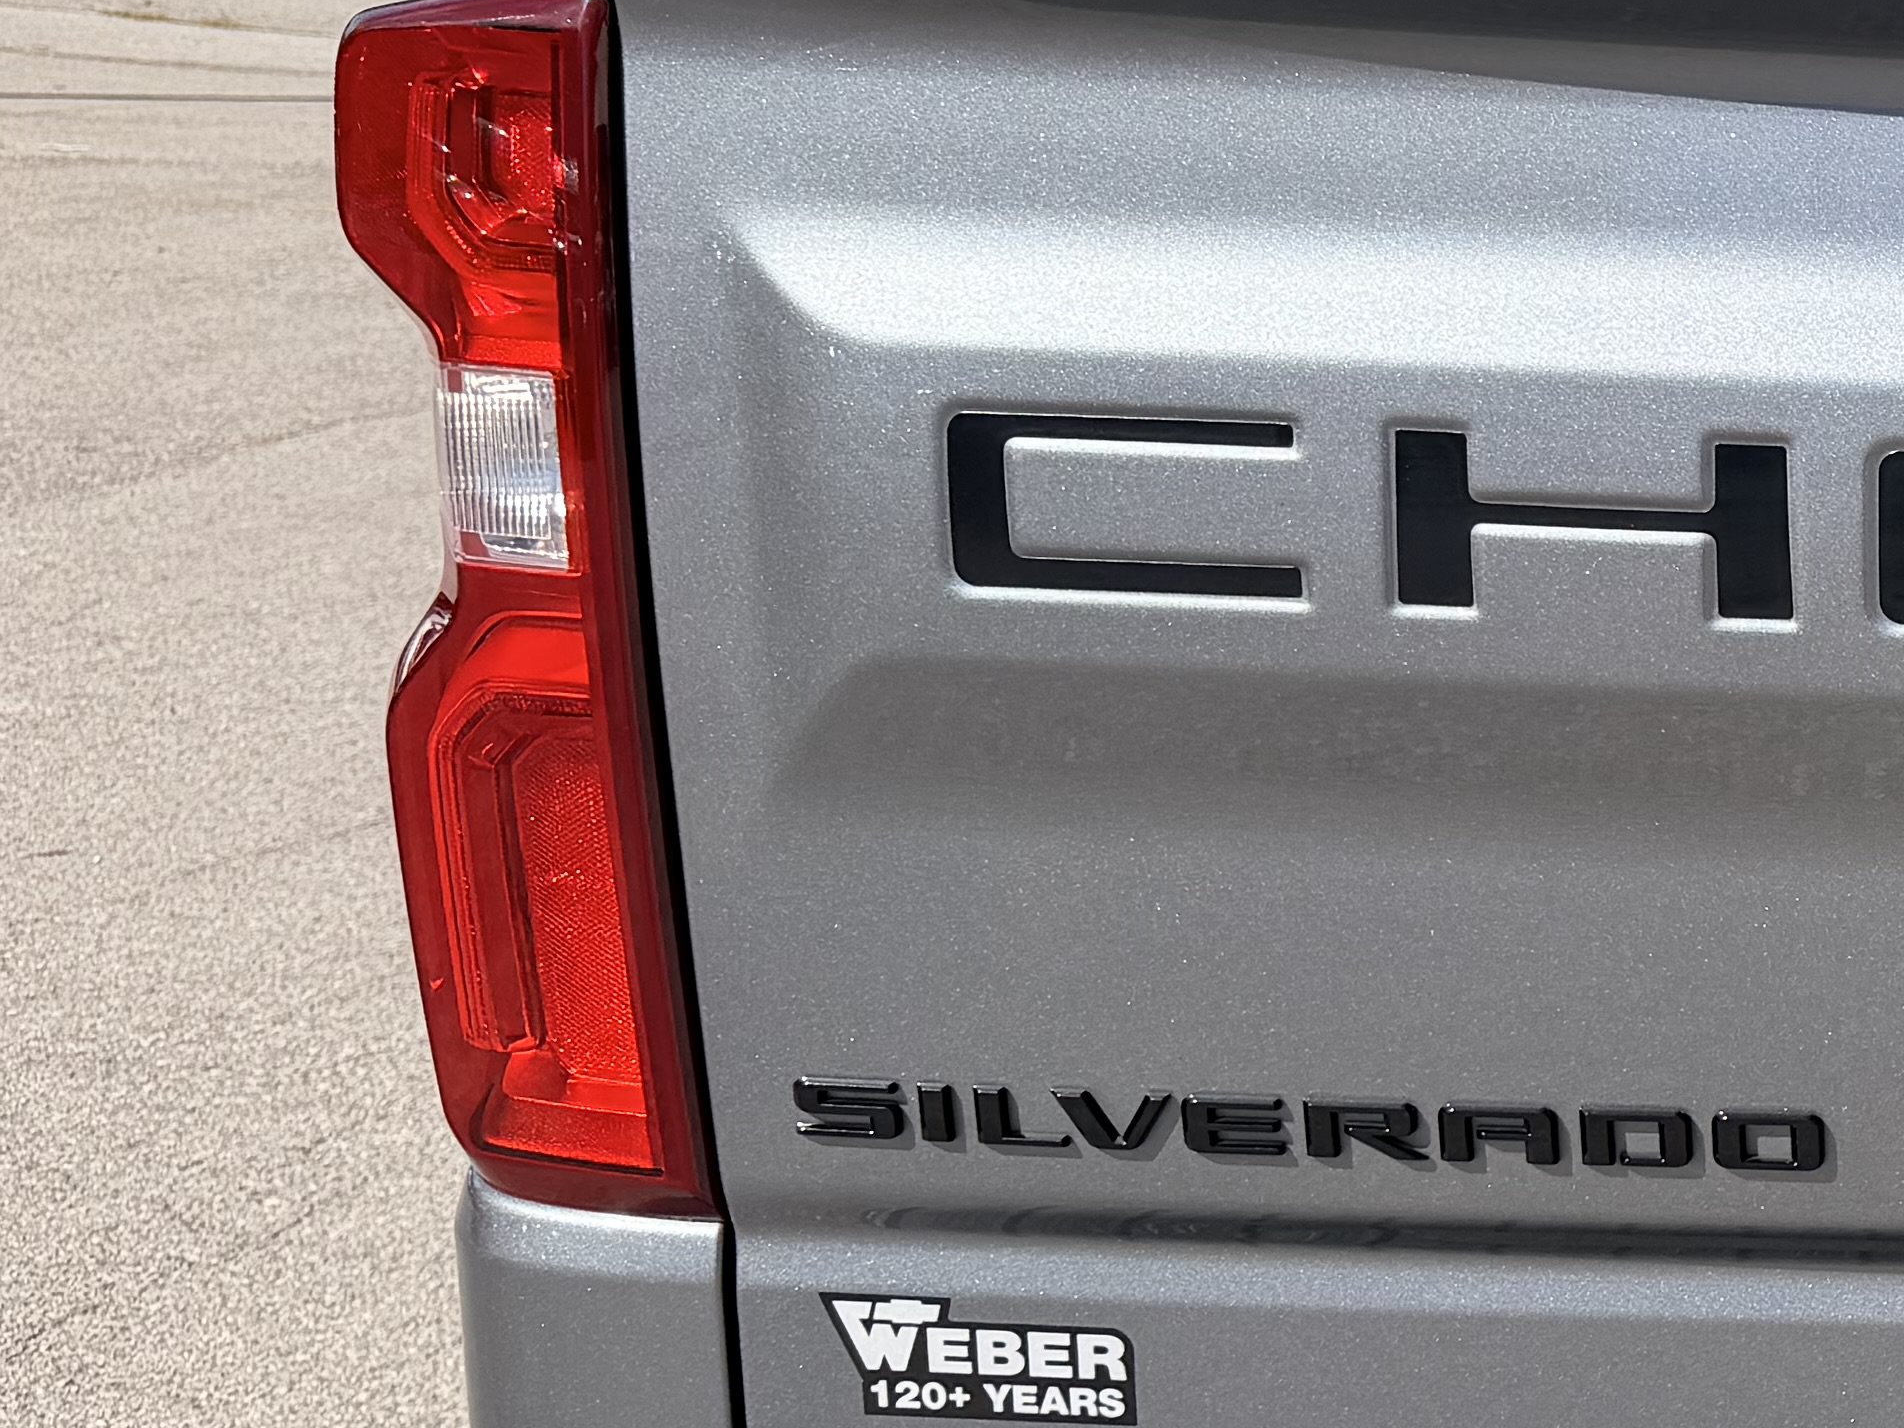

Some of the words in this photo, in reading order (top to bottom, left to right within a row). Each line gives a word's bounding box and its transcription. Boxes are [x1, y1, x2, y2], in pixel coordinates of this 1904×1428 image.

[793, 1075, 1824, 1171] SILVERADO
[831, 1298, 1128, 1382] WEBER
[870, 1378, 971, 1411] 120+
[983, 1383, 1126, 1419] YEARS
